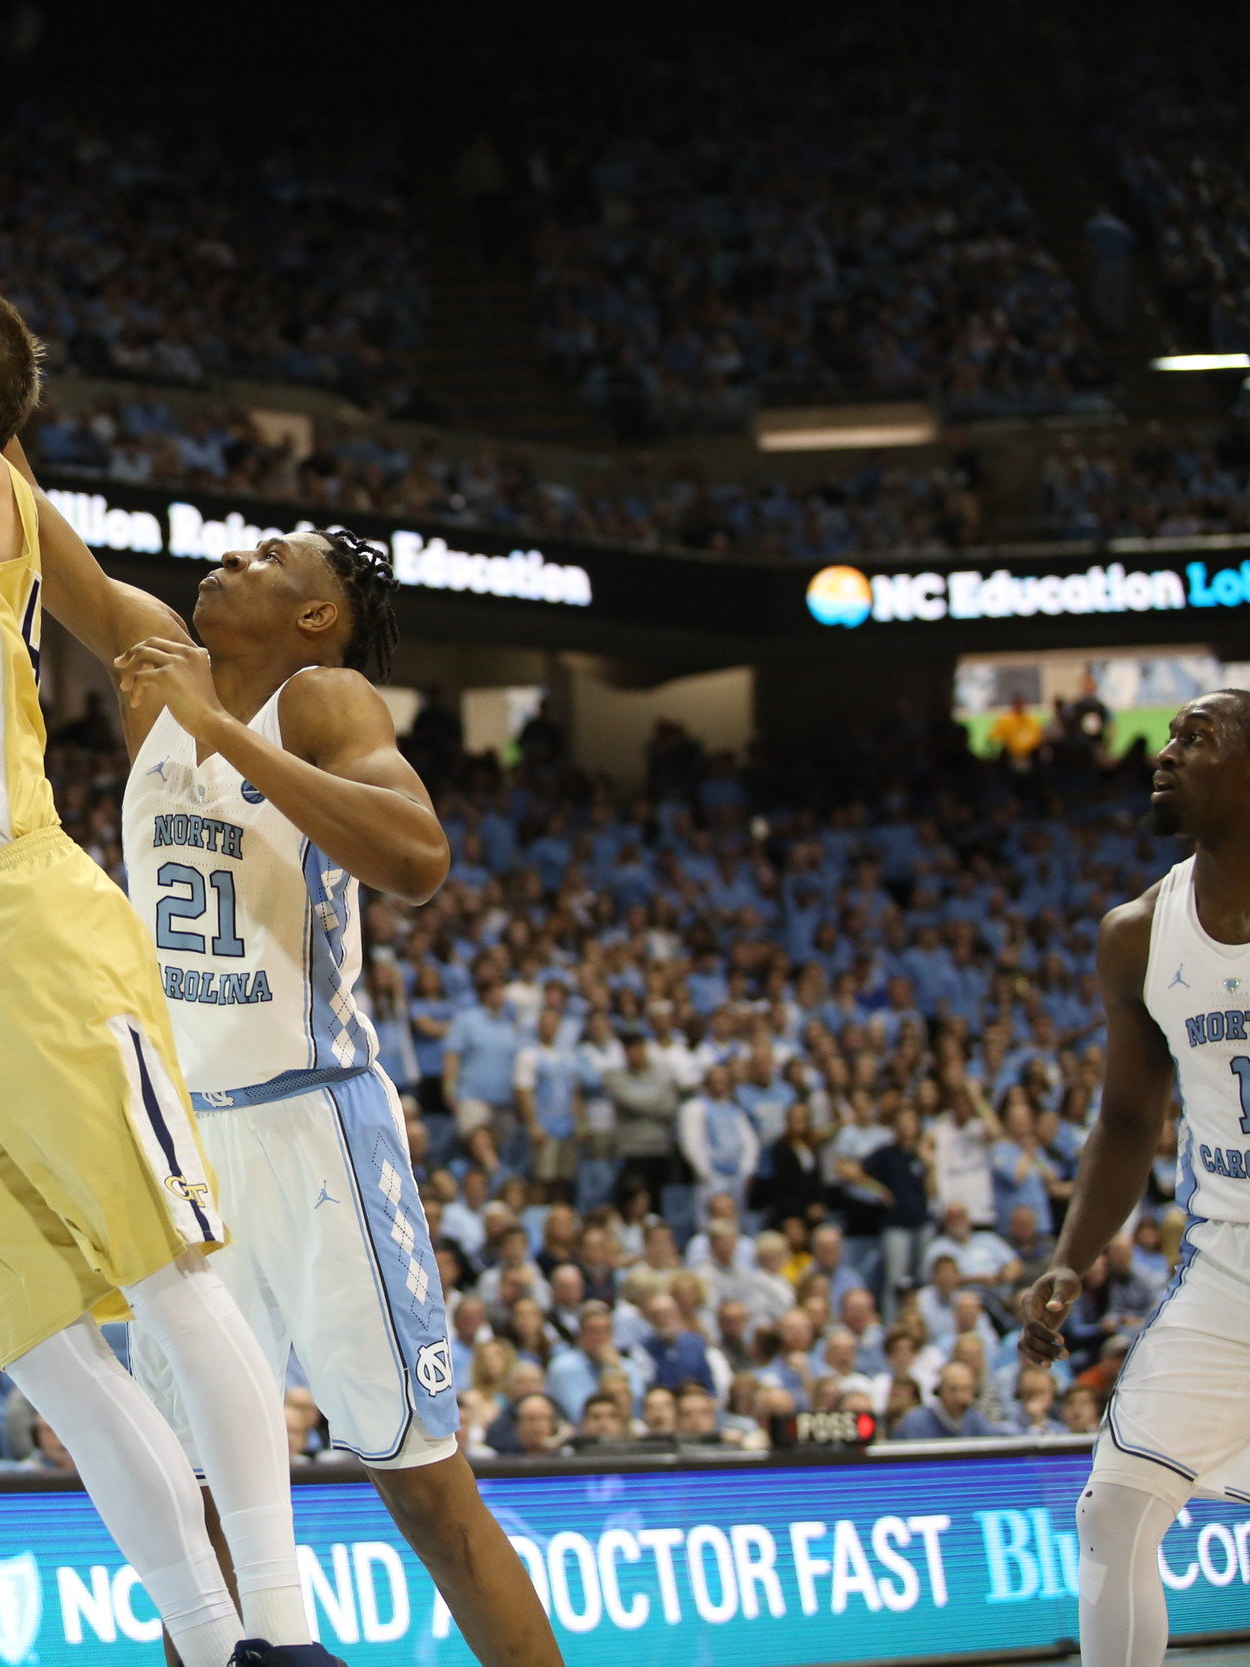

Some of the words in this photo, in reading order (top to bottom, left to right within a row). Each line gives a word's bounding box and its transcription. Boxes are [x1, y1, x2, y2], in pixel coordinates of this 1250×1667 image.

[391, 530, 592, 607] Education
[871, 572, 947, 623] NC
[947, 562, 1187, 620] Education
[153, 813, 244, 861] NORTH
[156, 861, 246, 958] 21
[158, 962, 273, 1006] ROLINA
[1185, 1009, 1250, 1048] NOR
[1199, 1143, 1250, 1179] CAR
[796, 1411, 857, 1443] POSS
[295, 1541, 411, 1645] ND
[789, 1514, 951, 1618] FAST
[973, 1507, 1080, 1603] Blu
[56, 1563, 164, 1644] NC
